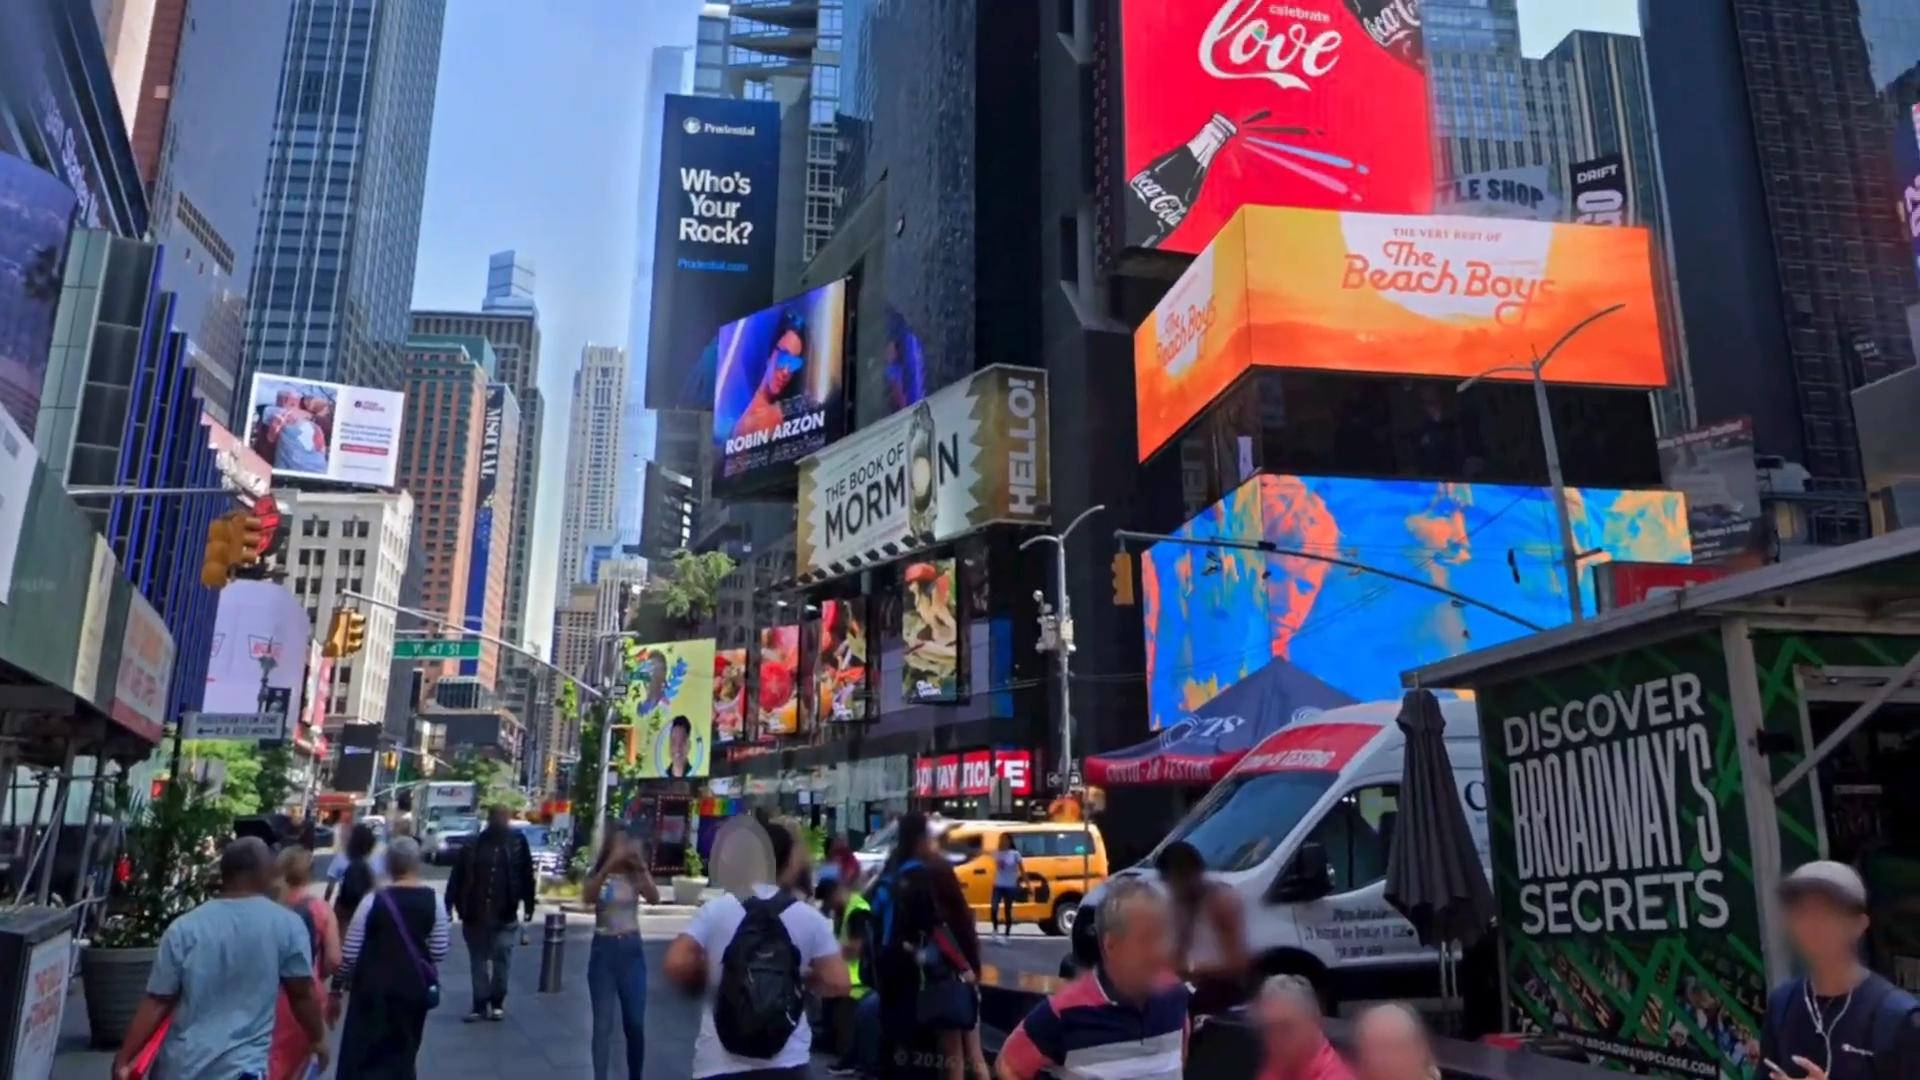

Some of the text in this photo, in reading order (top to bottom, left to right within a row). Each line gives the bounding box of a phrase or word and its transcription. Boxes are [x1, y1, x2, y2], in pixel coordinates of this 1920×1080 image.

[1269, 4, 1331, 23] celebrate
[1198, 0, 1342, 91] love
[704, 122, 756, 136] Prudential
[680, 167, 751, 195] Who's
[1576, 163, 1619, 185] DRIFT
[689, 193, 741, 218] Your
[1487, 178, 1544, 210] SHOP
[679, 217, 753, 245] Rock?
[1393, 227, 1503, 243] THE VERY BEST OF
[1382, 239, 1437, 269] The
[1341, 253, 1556, 328] Beach Boys
[725, 428, 770, 455] ROBIN
[1007, 376, 1037, 515] HELLO!
[824, 477, 847, 504] THE
[849, 457, 884, 491] BOOK
[887, 441, 905, 467] OF
[428, 643, 444, 655] 47
[1503, 672, 1705, 757] DISCOVER
[1509, 722, 1722, 880] BROADWAY'S
[1519, 869, 1730, 935] SECRETS
